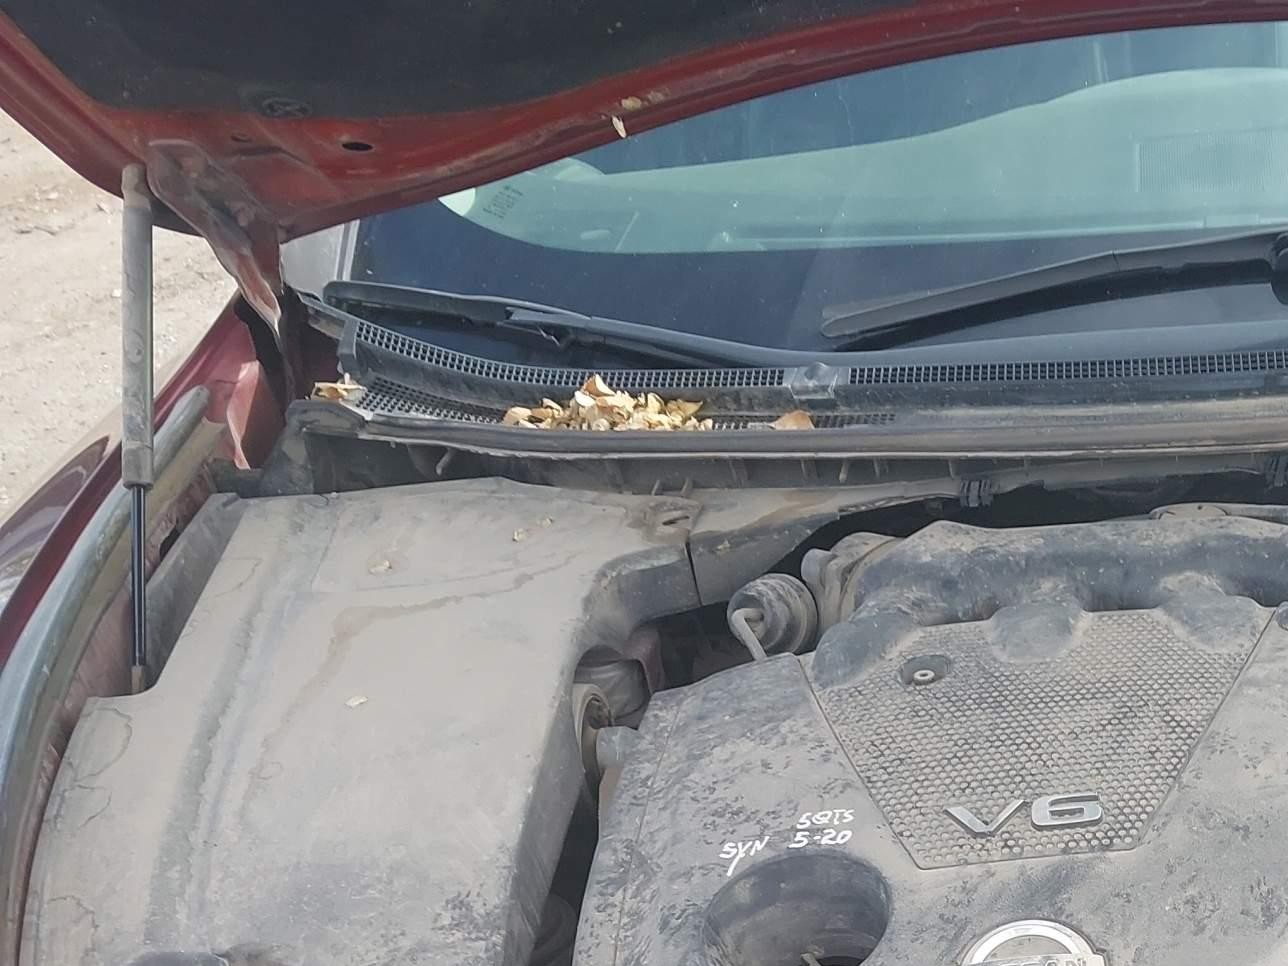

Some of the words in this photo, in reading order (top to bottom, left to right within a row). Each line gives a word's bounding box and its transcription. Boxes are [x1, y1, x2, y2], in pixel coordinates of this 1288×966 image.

[943, 792, 1102, 837] V6
[718, 836, 770, 876] SYN
[787, 828, 853, 848] 5-20
